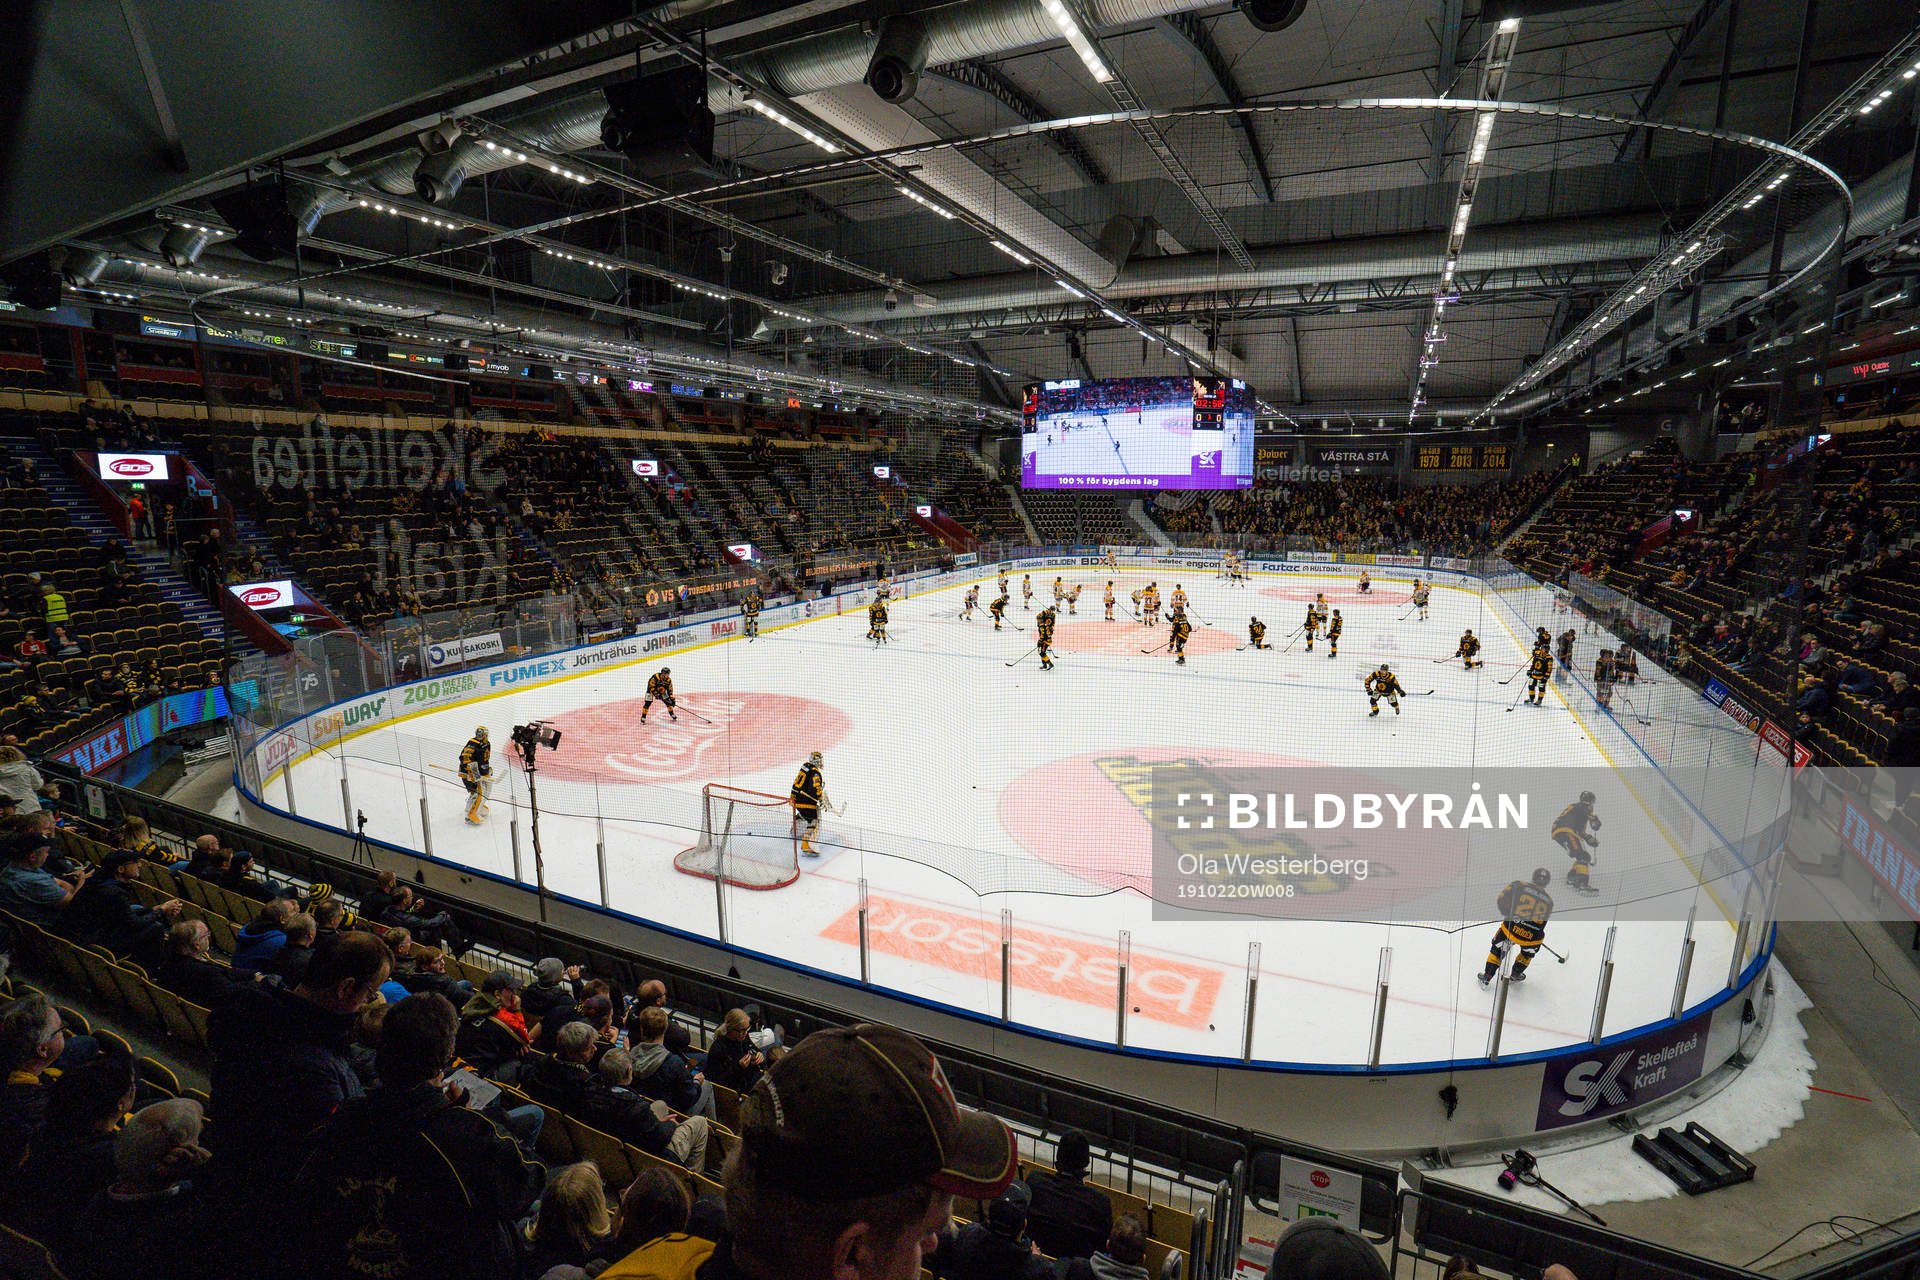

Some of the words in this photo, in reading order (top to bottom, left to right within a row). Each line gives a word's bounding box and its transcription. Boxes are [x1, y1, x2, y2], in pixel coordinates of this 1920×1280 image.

[1321, 451, 1364, 461] VÄSTRA
[1367, 450, 1389, 461] STÅ
[1420, 455, 1440, 468] 1978
[1450, 455, 1472, 467] 2013
[1483, 454, 1505, 467] 2014
[1058, 477, 1074, 485] 100
[1076, 477, 1084, 485] %
[1086, 476, 1101, 485] för
[1102, 476, 1141, 488] bygdens
[1143, 476, 1159, 488] lag
[1255, 464, 1342, 483] kellefteå
[1081, 557, 1109, 566] BDX
[1186, 560, 1221, 569] engcon
[1262, 563, 1301, 572] Fastec
[573, 644, 637, 667] Jörnträhus
[489, 658, 566, 687] FUMEX
[403, 682, 441, 705] 200
[441, 675, 473, 689] METER
[443, 680, 478, 697] HOCKEY
[314, 697, 386, 740] SUBWAY
[57, 728, 123, 776] NKE
[868, 902, 1198, 1014] betsson
[1637, 1033, 1698, 1070] Skellefteå
[1558, 1049, 1635, 1116] SK
[1633, 1066, 1667, 1090] Kraft
[1311, 1173, 1330, 1184] STOP
